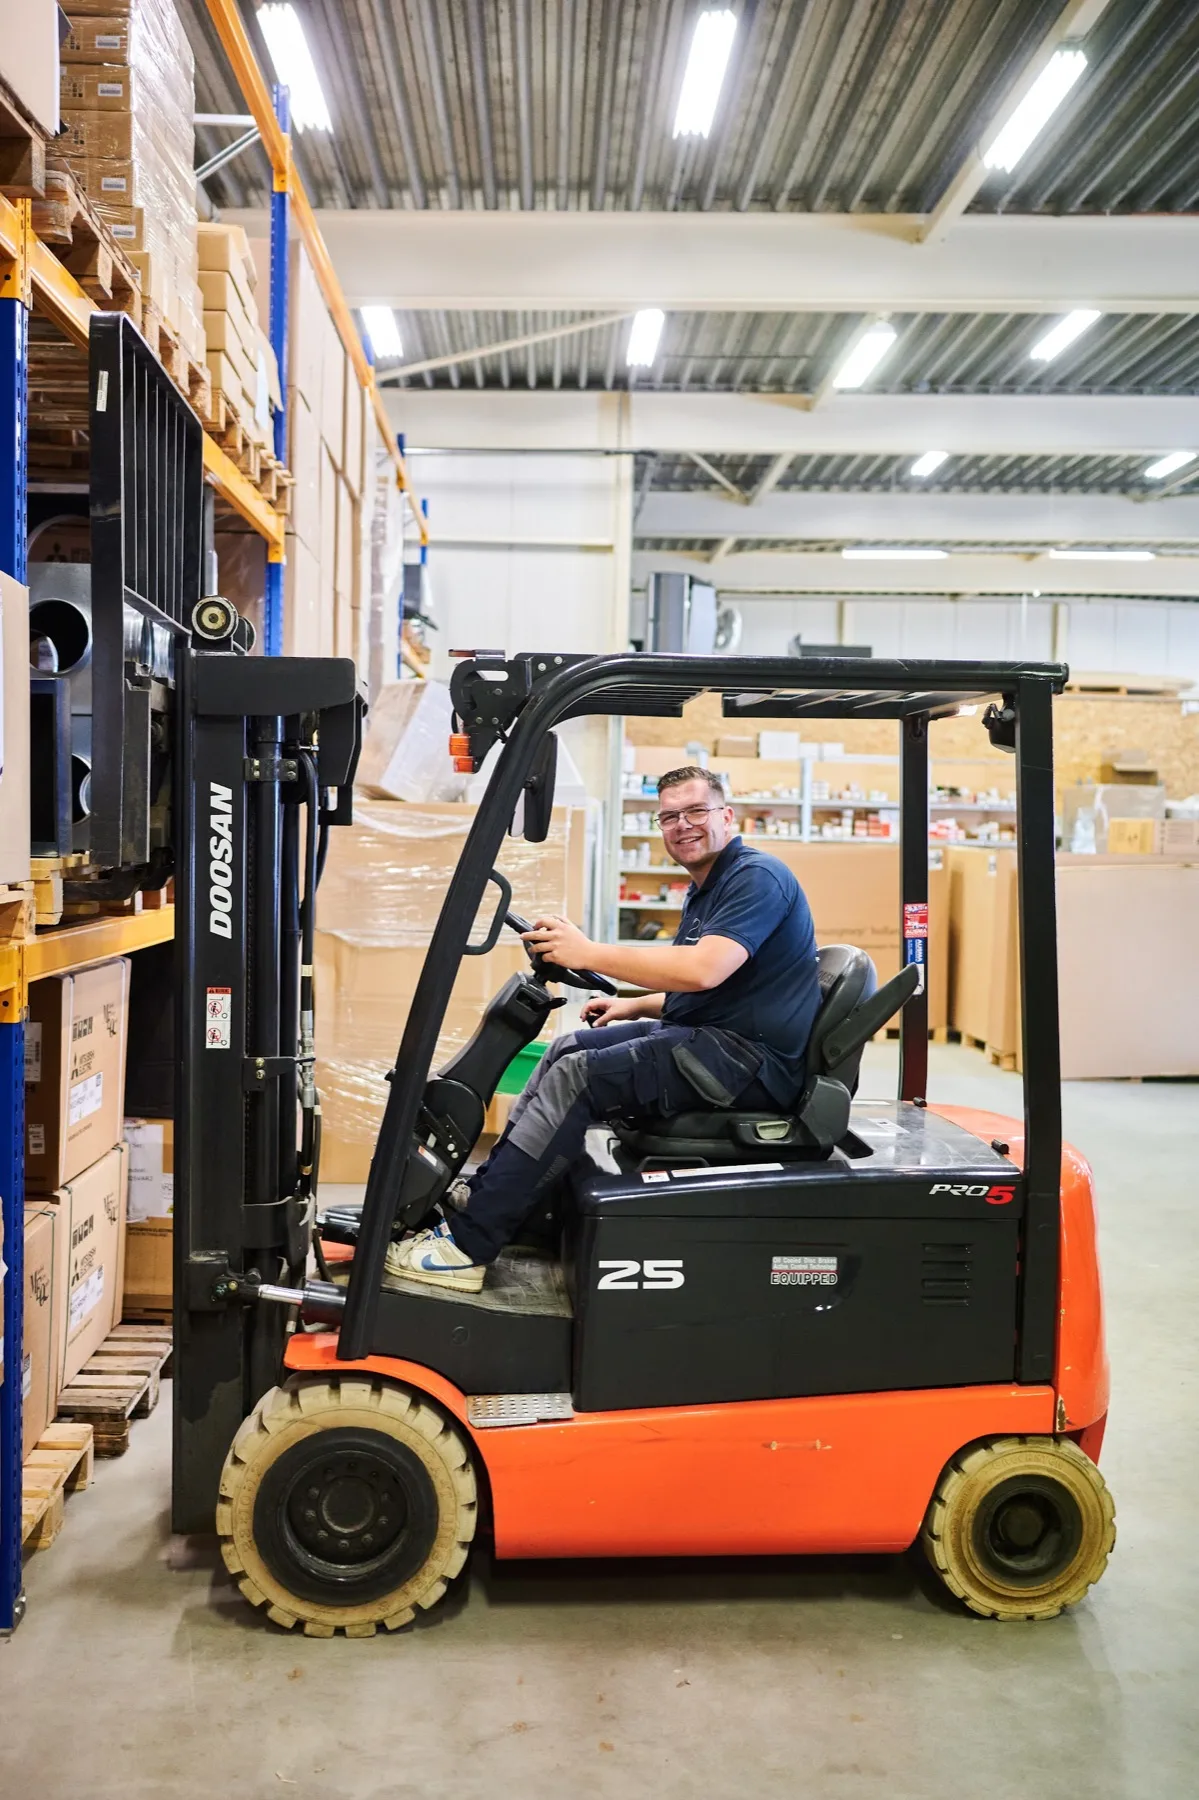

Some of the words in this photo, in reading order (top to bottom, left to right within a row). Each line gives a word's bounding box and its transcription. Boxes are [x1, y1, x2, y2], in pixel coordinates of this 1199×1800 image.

[209, 781, 233, 939] DOOSAN
[928, 1184, 1016, 1205] PRO5
[597, 1260, 685, 1290] 25
[770, 1272, 838, 1285] EQUIPPED
